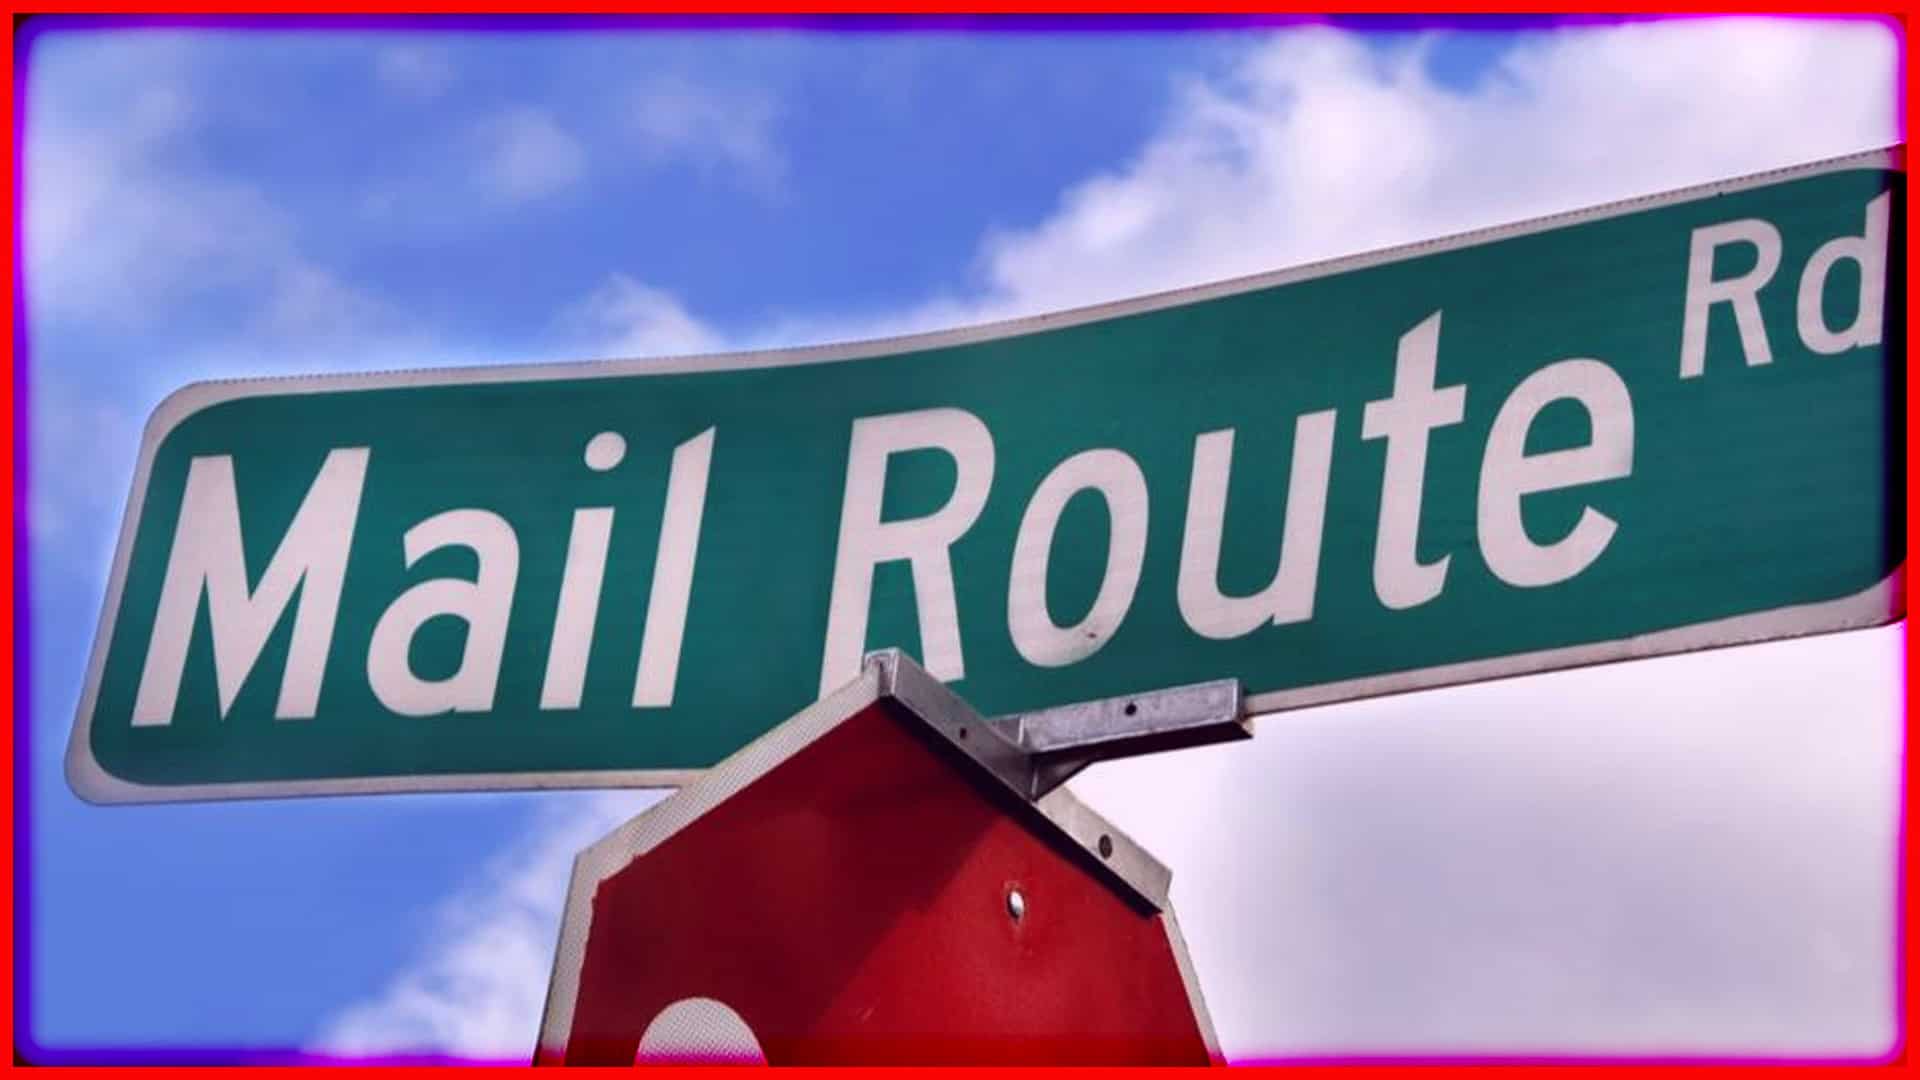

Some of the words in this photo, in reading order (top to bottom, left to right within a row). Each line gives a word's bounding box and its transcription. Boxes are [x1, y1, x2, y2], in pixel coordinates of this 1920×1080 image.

[131, 426, 716, 727] Mail
[818, 309, 1635, 698] Route
[1679, 190, 1891, 380] Rd
